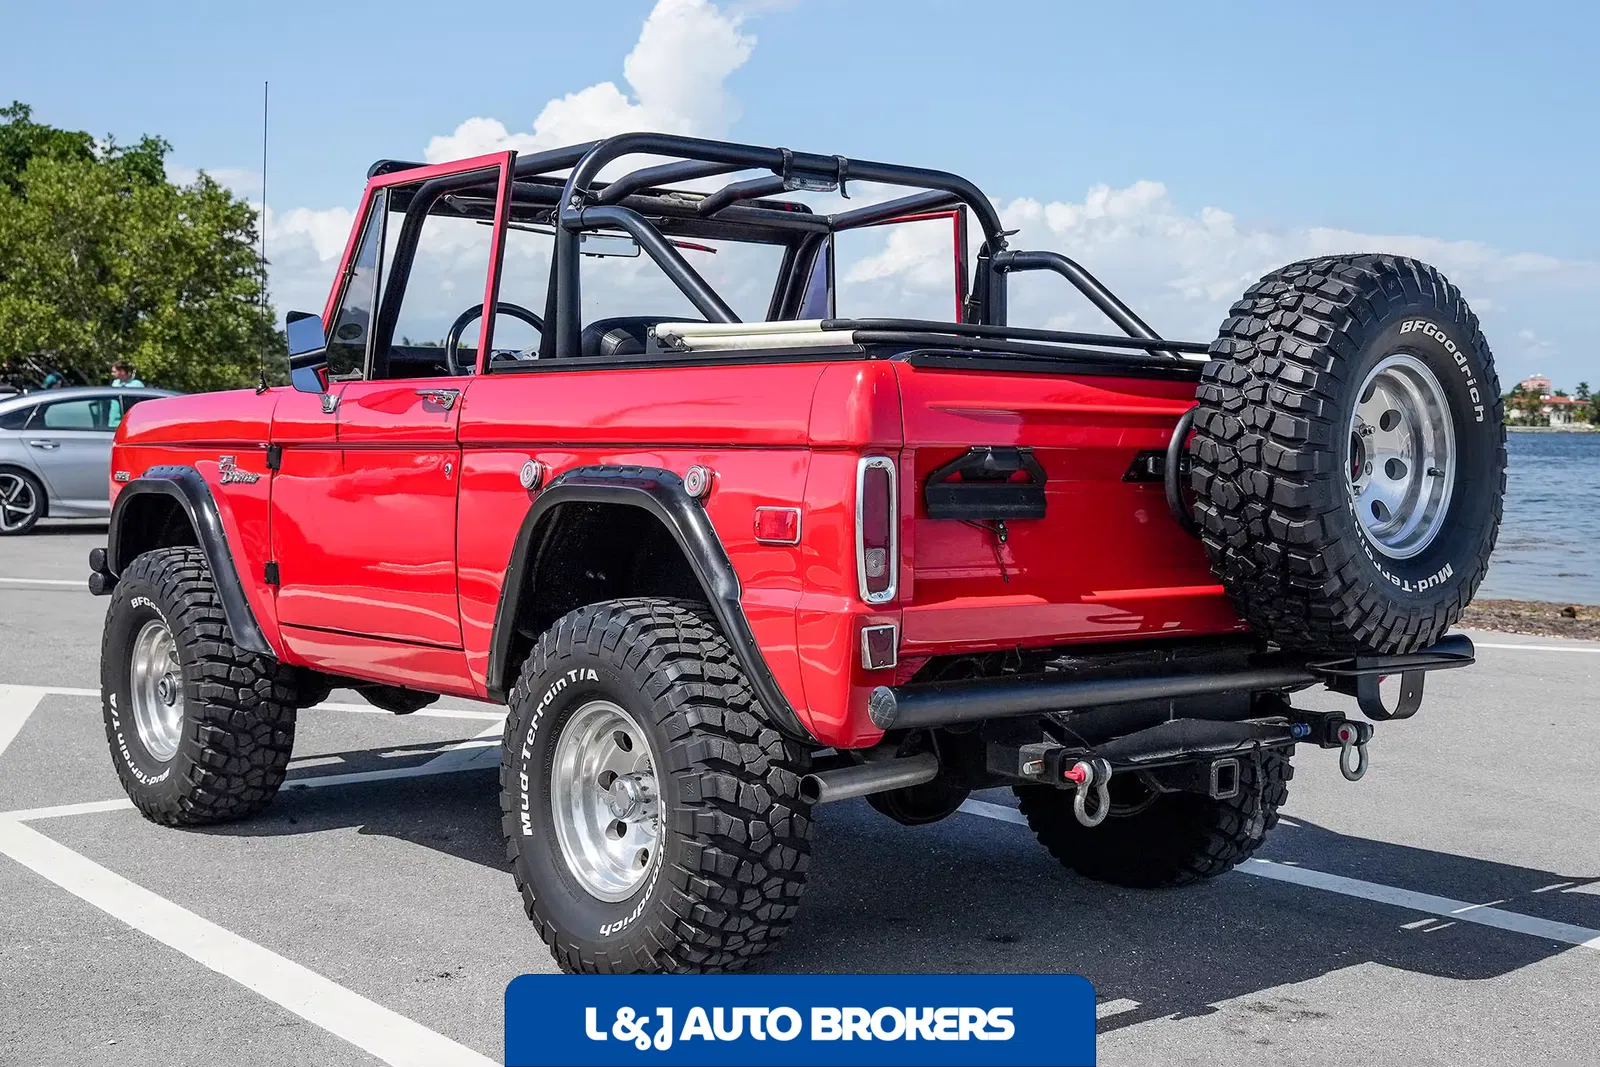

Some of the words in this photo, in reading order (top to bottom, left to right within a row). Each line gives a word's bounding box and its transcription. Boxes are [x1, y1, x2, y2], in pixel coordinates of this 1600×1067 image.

[1400, 320, 1485, 422] BFGoodrich
[1354, 520, 1454, 592] Mud-Terrain
[109, 692, 121, 731] T/A
[117, 732, 171, 786] Mud-Terrain
[520, 677, 568, 836] Mud-Terrain
[567, 668, 600, 682] T/A
